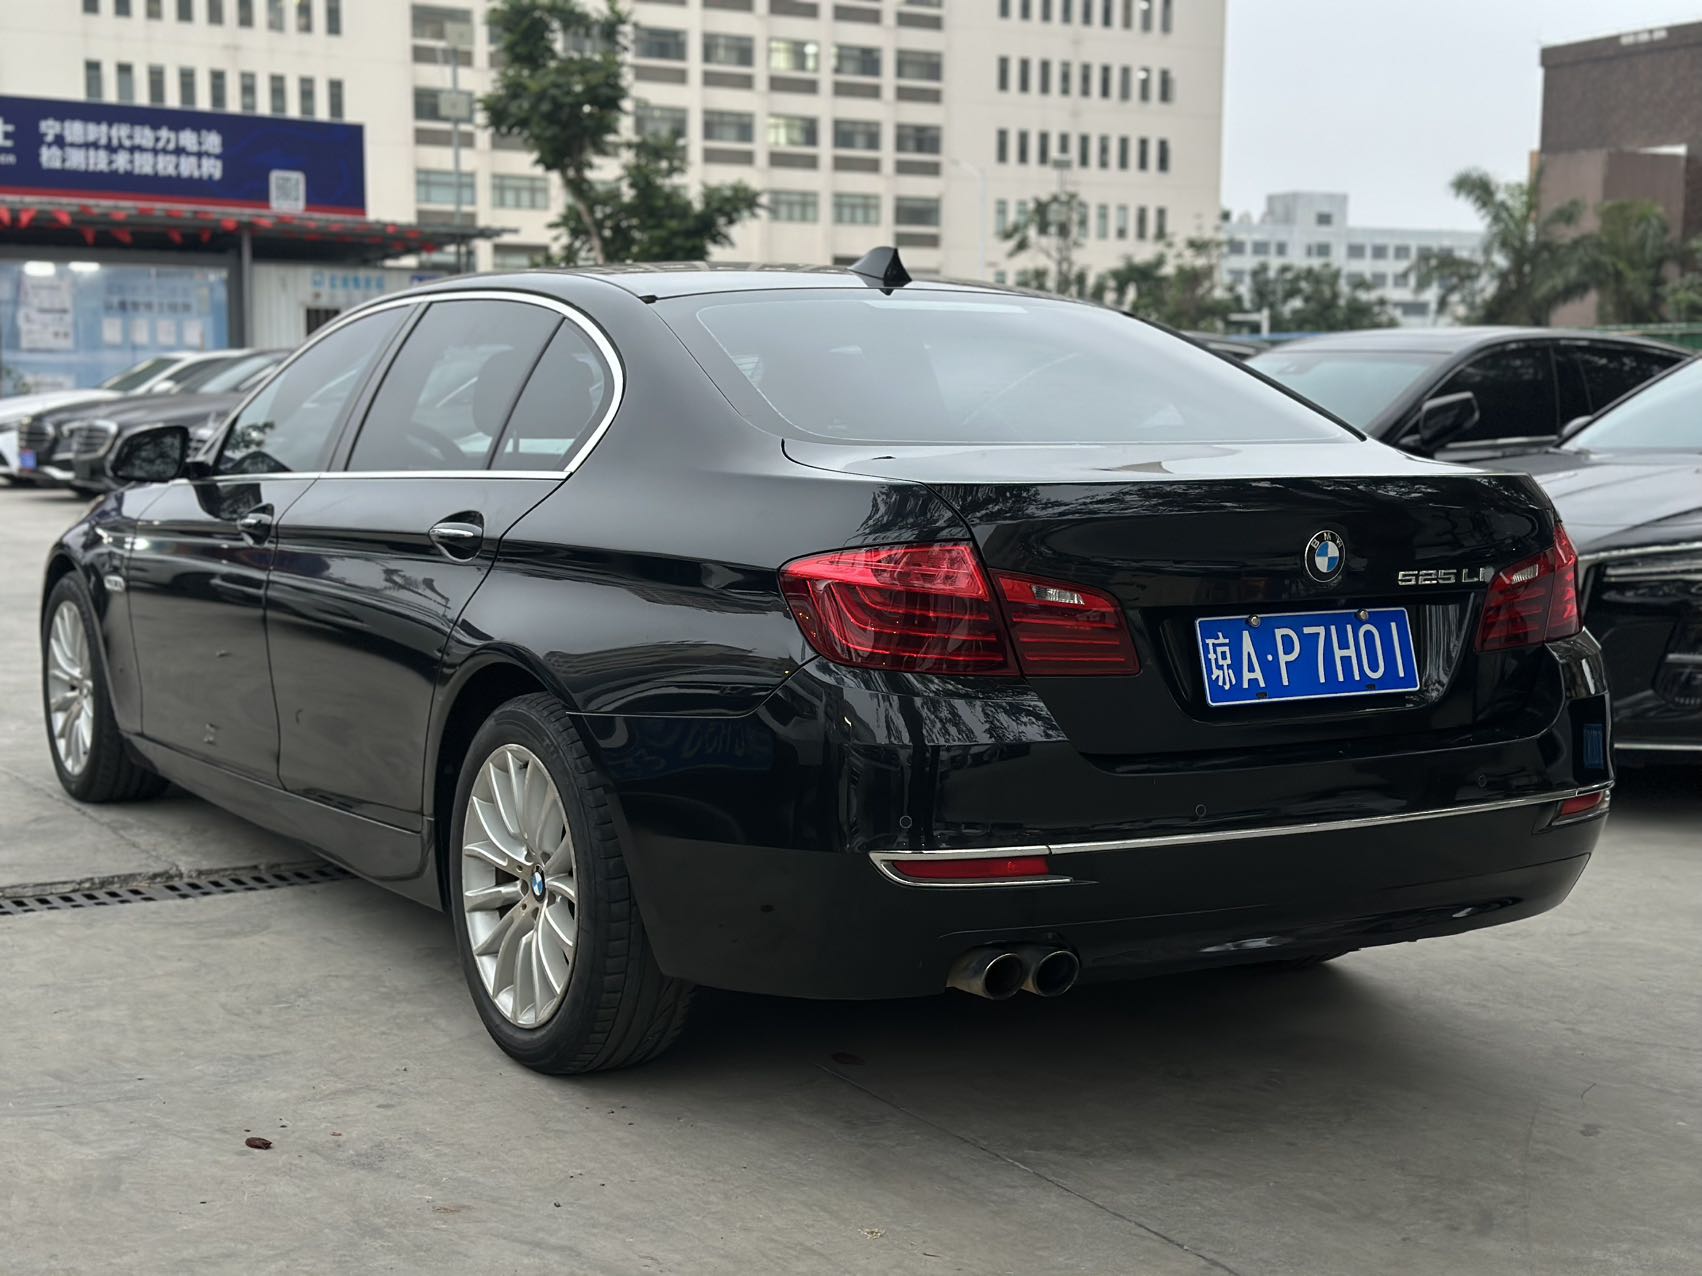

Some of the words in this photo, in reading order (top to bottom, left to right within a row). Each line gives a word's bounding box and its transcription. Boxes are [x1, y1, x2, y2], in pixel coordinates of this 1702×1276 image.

[39, 118, 223, 154] 宁德时代动力电池
[1310, 532, 1343, 548] BMW
